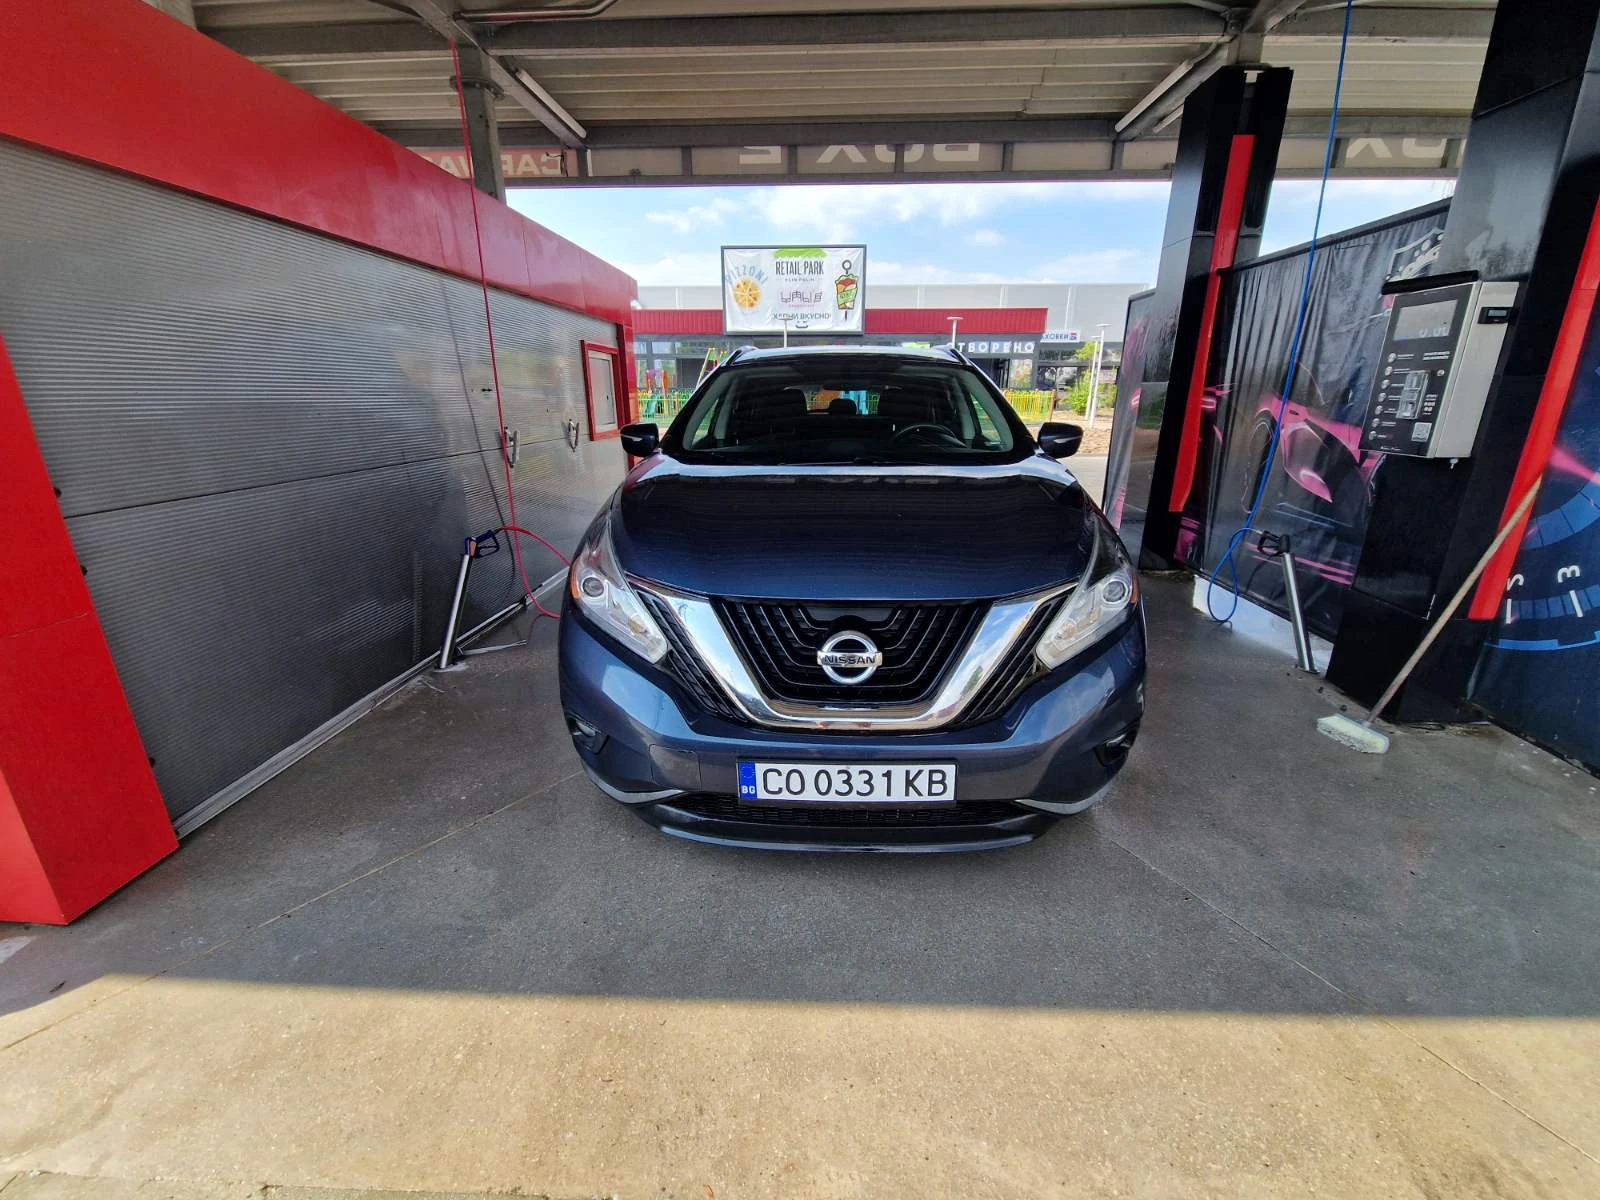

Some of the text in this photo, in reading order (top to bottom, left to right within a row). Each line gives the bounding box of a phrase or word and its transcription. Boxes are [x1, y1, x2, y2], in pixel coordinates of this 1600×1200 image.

[775, 260, 824, 275] RETAIL PARK
[823, 655, 876, 665] NISSAN
[762, 768, 948, 797] CO 0331 KB
[741, 785, 756, 794] BG
